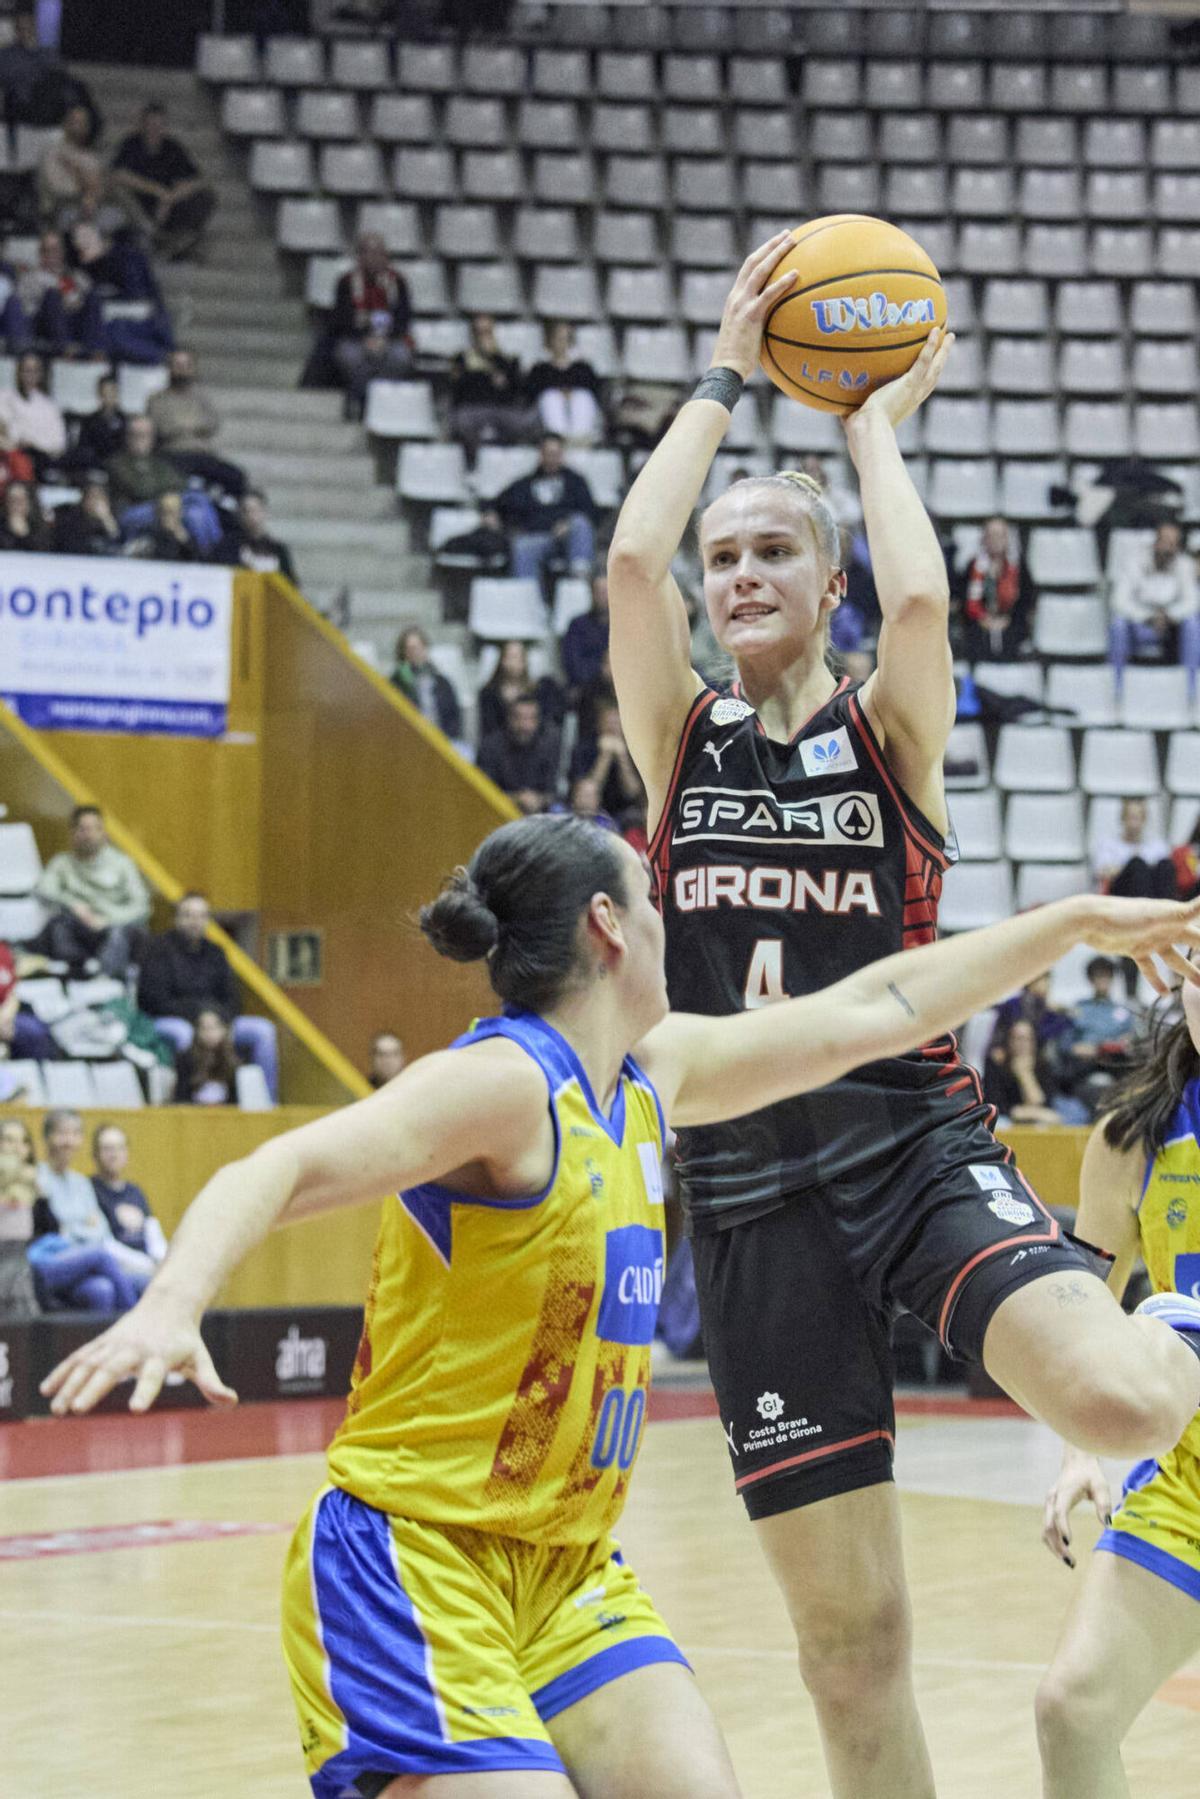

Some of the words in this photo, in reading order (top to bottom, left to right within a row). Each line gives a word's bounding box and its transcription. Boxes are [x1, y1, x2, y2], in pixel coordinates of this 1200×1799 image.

[811, 292, 935, 334] Wilson
[0, 581, 214, 637] ontepio
[681, 799, 820, 832] SPAR
[673, 865, 882, 917] GIRONA
[745, 938, 791, 1011] 4
[618, 1257, 663, 1305] CADÍ
[590, 1386, 645, 1470] 00
[743, 1437, 775, 1453] Pirineu
[776, 1432, 788, 1444] de
[789, 1424, 823, 1439] Girona
[749, 1425, 777, 1439] Costa
[777, 1417, 808, 1432] Brava
